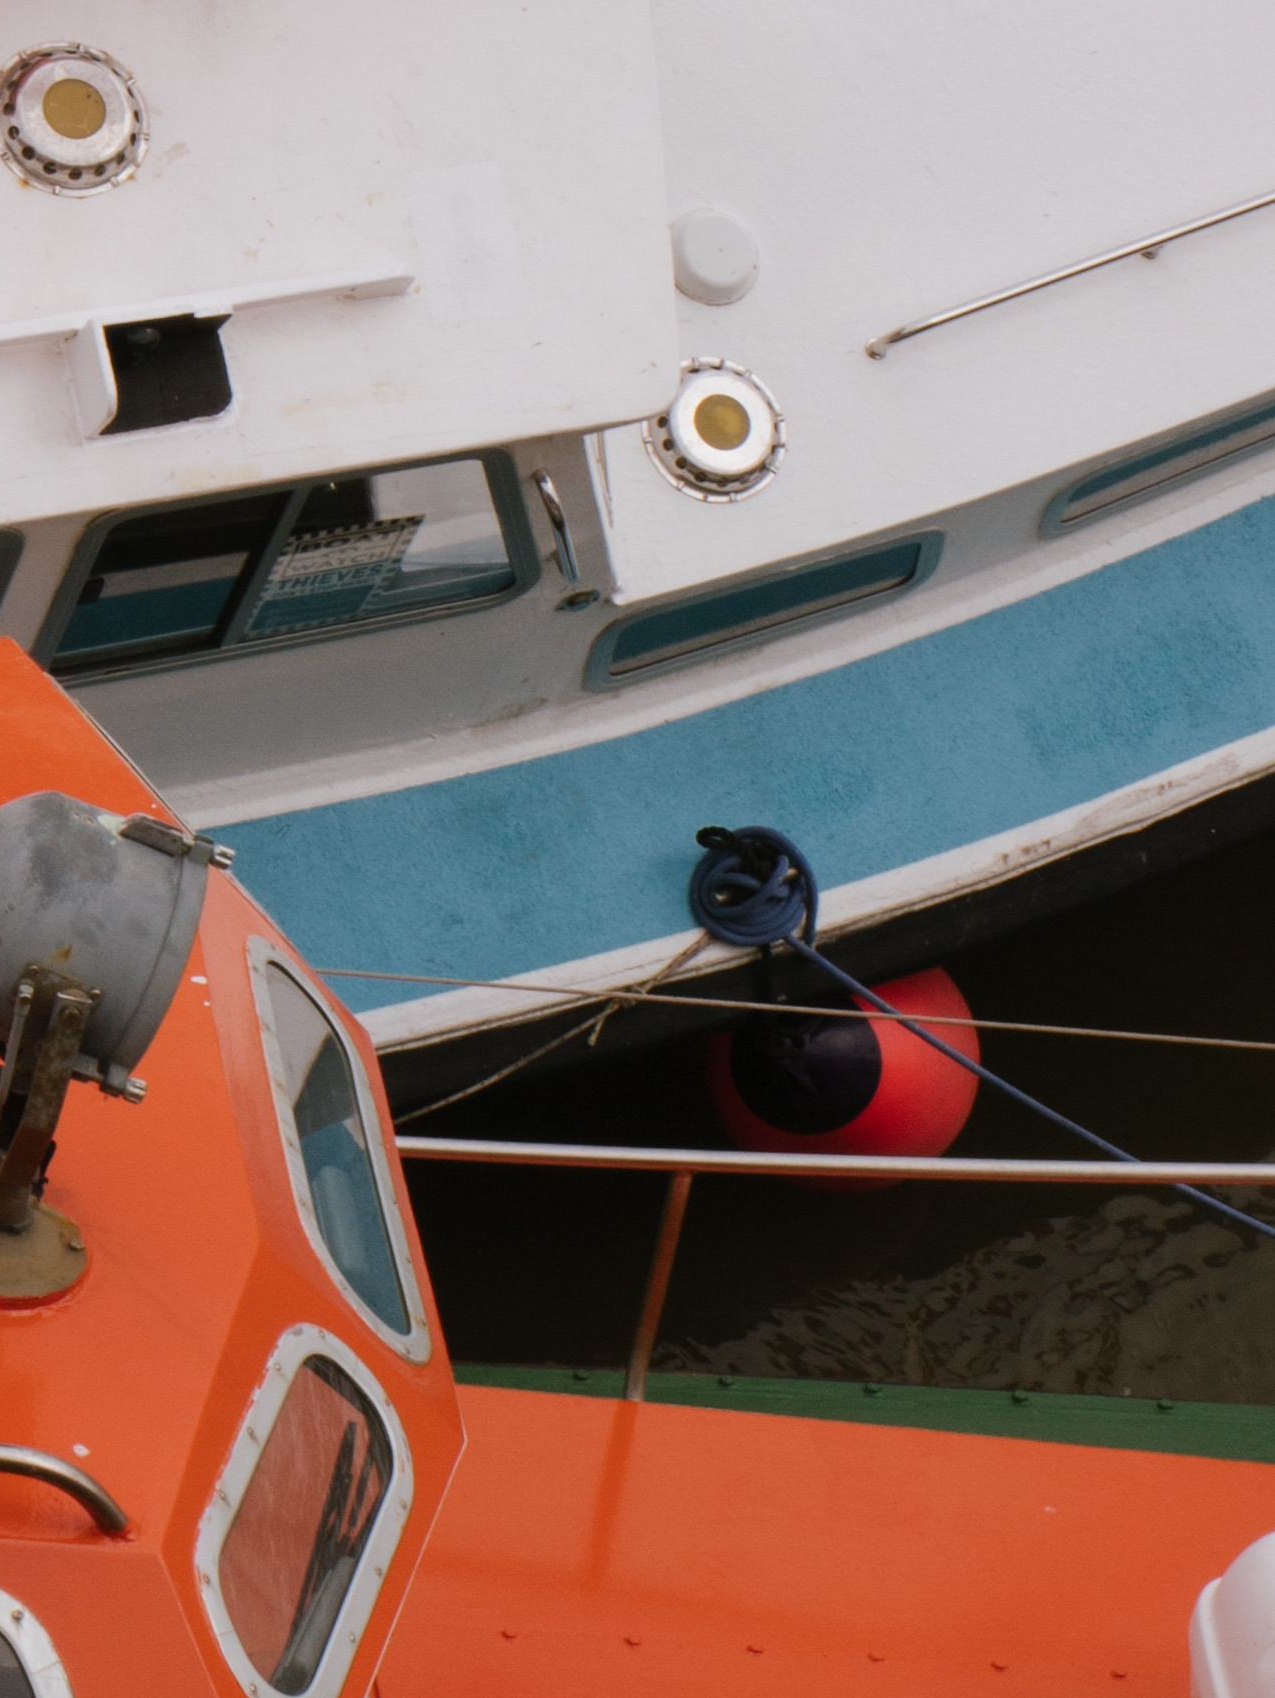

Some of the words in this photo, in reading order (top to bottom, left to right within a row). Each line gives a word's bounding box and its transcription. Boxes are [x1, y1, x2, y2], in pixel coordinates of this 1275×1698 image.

[298, 526, 404, 554] BOAT
[289, 550, 389, 574] WATCH
[276, 563, 383, 591] THIEVES
